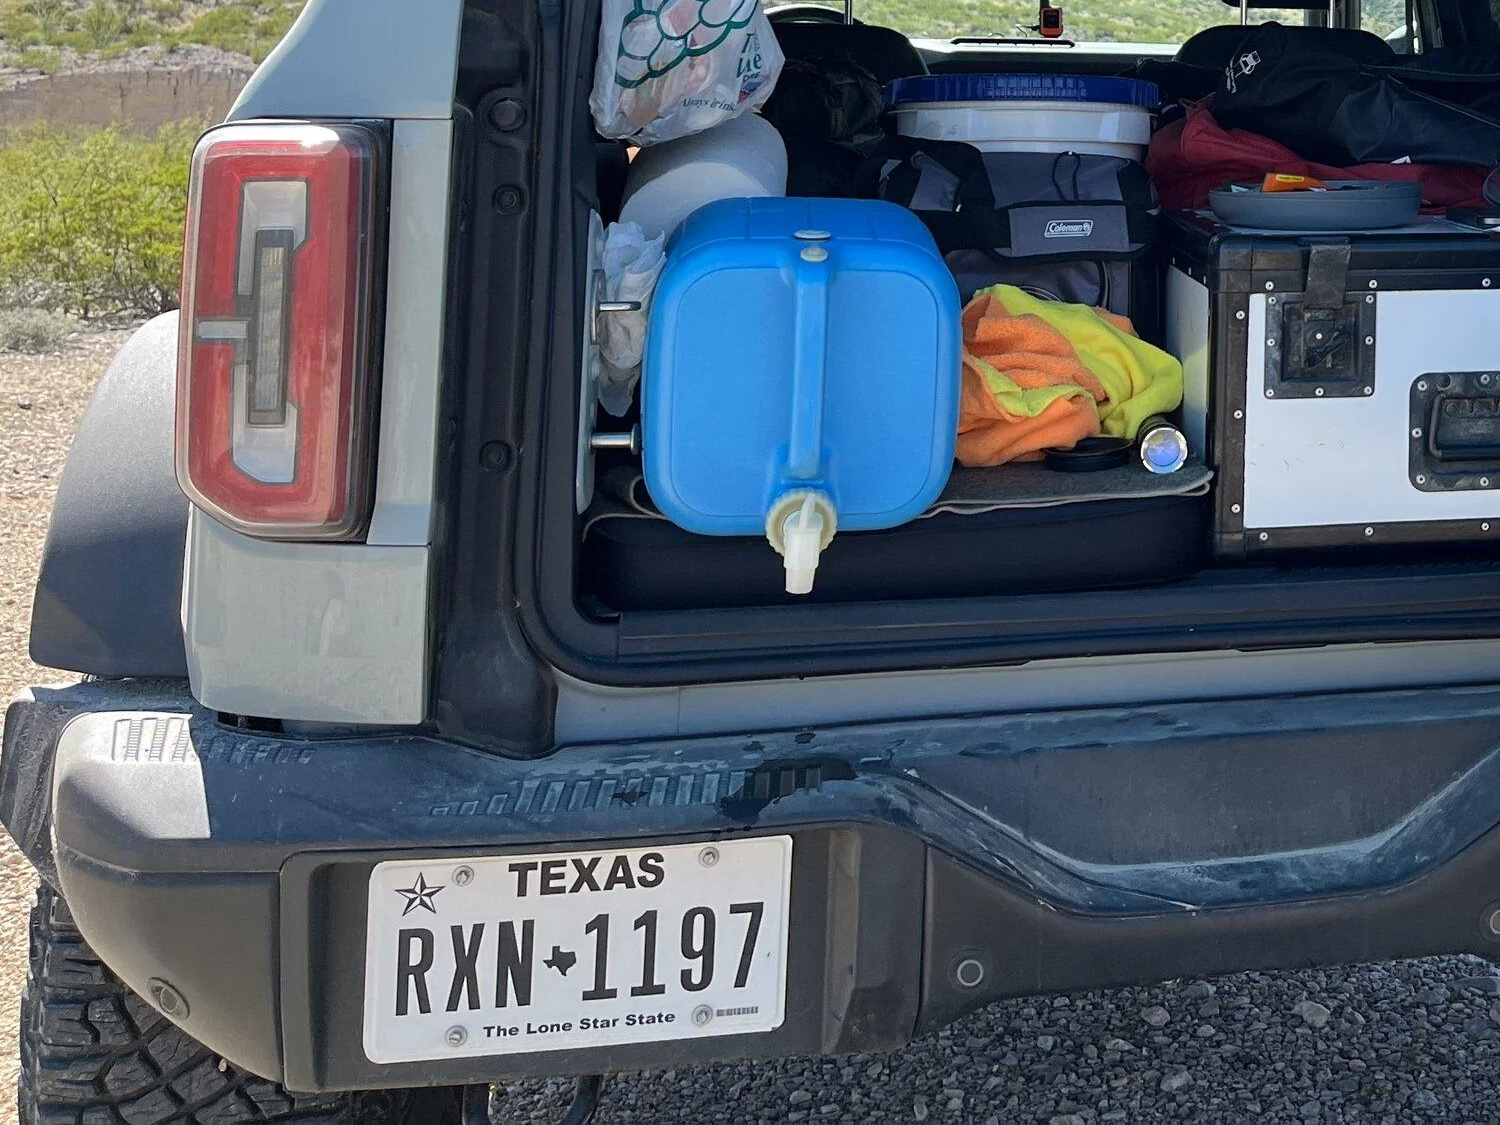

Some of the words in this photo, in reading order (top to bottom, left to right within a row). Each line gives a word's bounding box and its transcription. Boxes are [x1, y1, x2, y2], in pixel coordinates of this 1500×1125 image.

[1049, 222, 1083, 233] Coleman
[508, 852, 665, 898] TEXAS
[483, 1024, 519, 1038] The
[526, 1022, 572, 1035] Lone
[579, 1017, 619, 1031] Star
[625, 1011, 676, 1026] State
